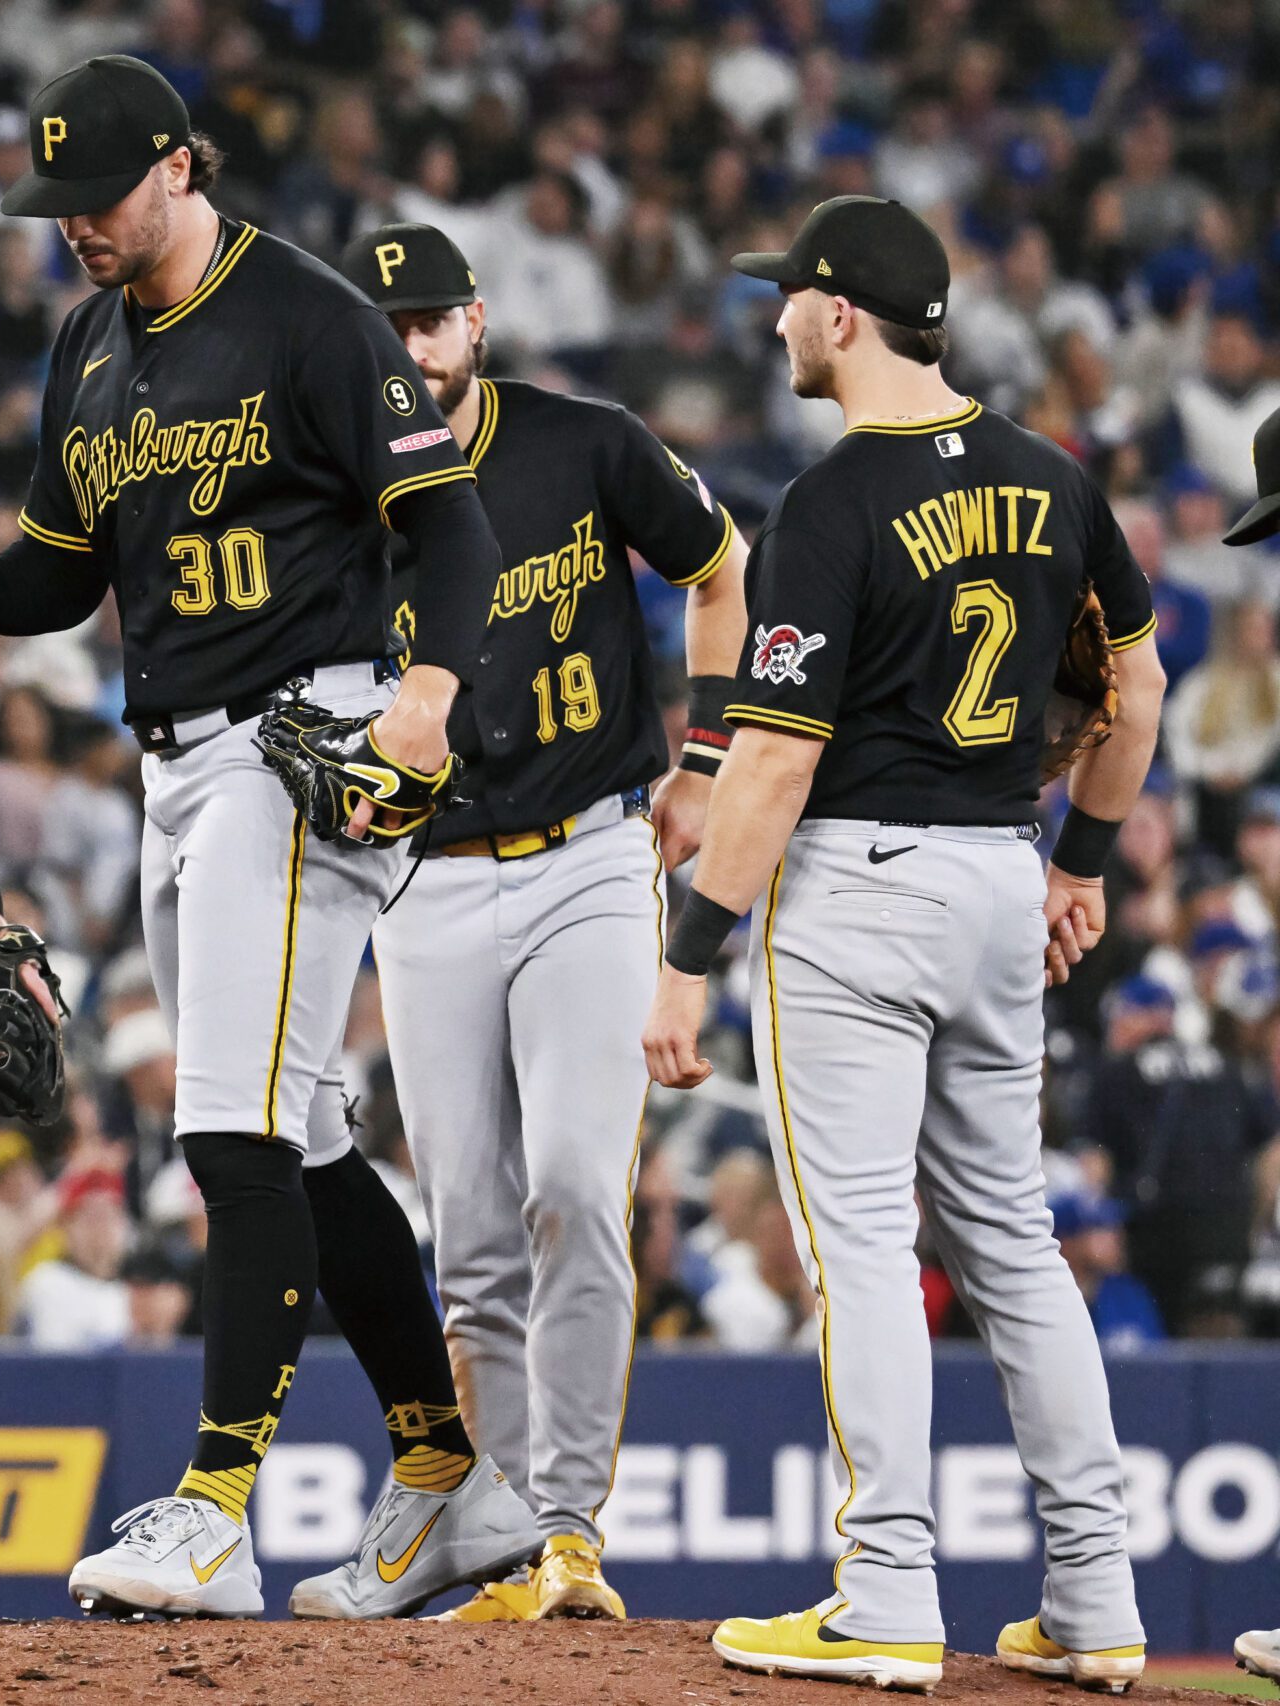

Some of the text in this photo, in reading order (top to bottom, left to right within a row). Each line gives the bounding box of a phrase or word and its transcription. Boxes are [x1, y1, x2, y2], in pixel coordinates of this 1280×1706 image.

[42, 116, 67, 162] P
[375, 241, 406, 287] P
[390, 382, 410, 410] 9
[392, 429, 449, 452] SHEETZ
[166, 526, 272, 616] 30
[942, 578, 1020, 747] 2
[532, 652, 602, 744] 19
